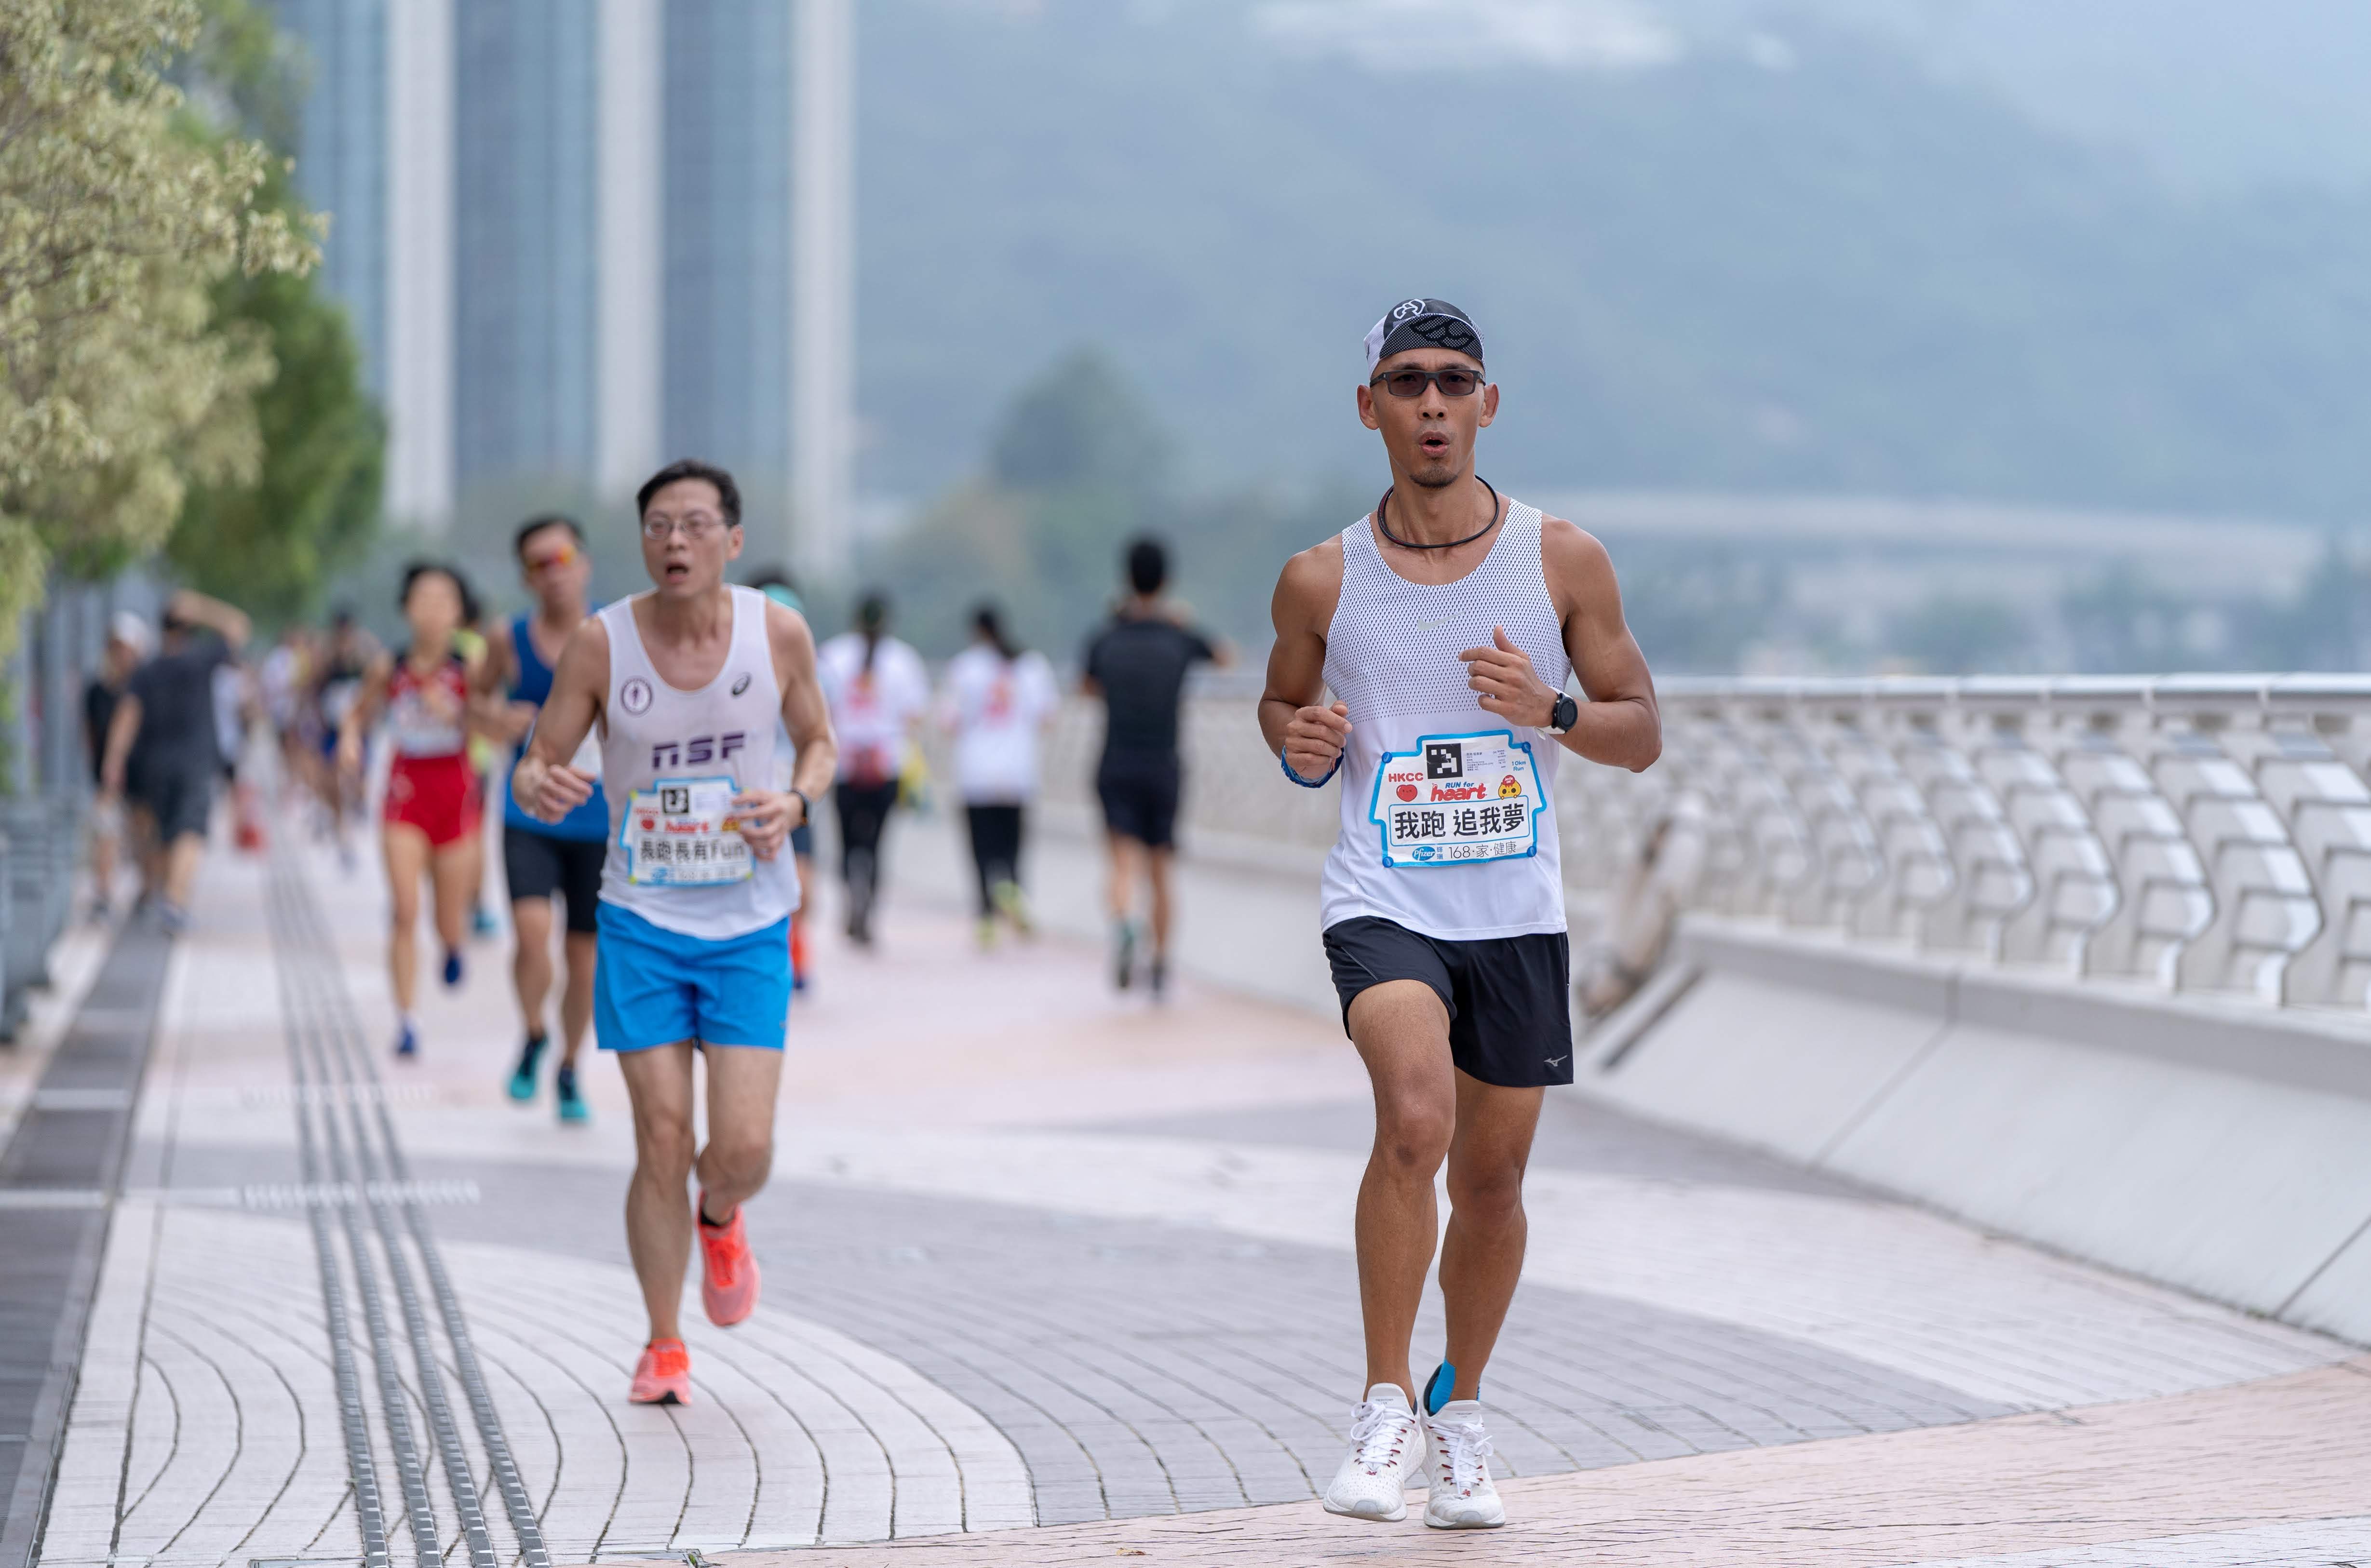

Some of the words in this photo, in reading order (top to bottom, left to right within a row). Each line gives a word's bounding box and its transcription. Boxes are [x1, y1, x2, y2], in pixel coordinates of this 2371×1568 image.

[1388, 773, 1424, 782] HKCC
[1430, 783, 1486, 802] heart
[1395, 810, 1446, 839] 我跑
[1453, 803, 1524, 836] 追我夢
[1414, 848, 1435, 861] Pfizer
